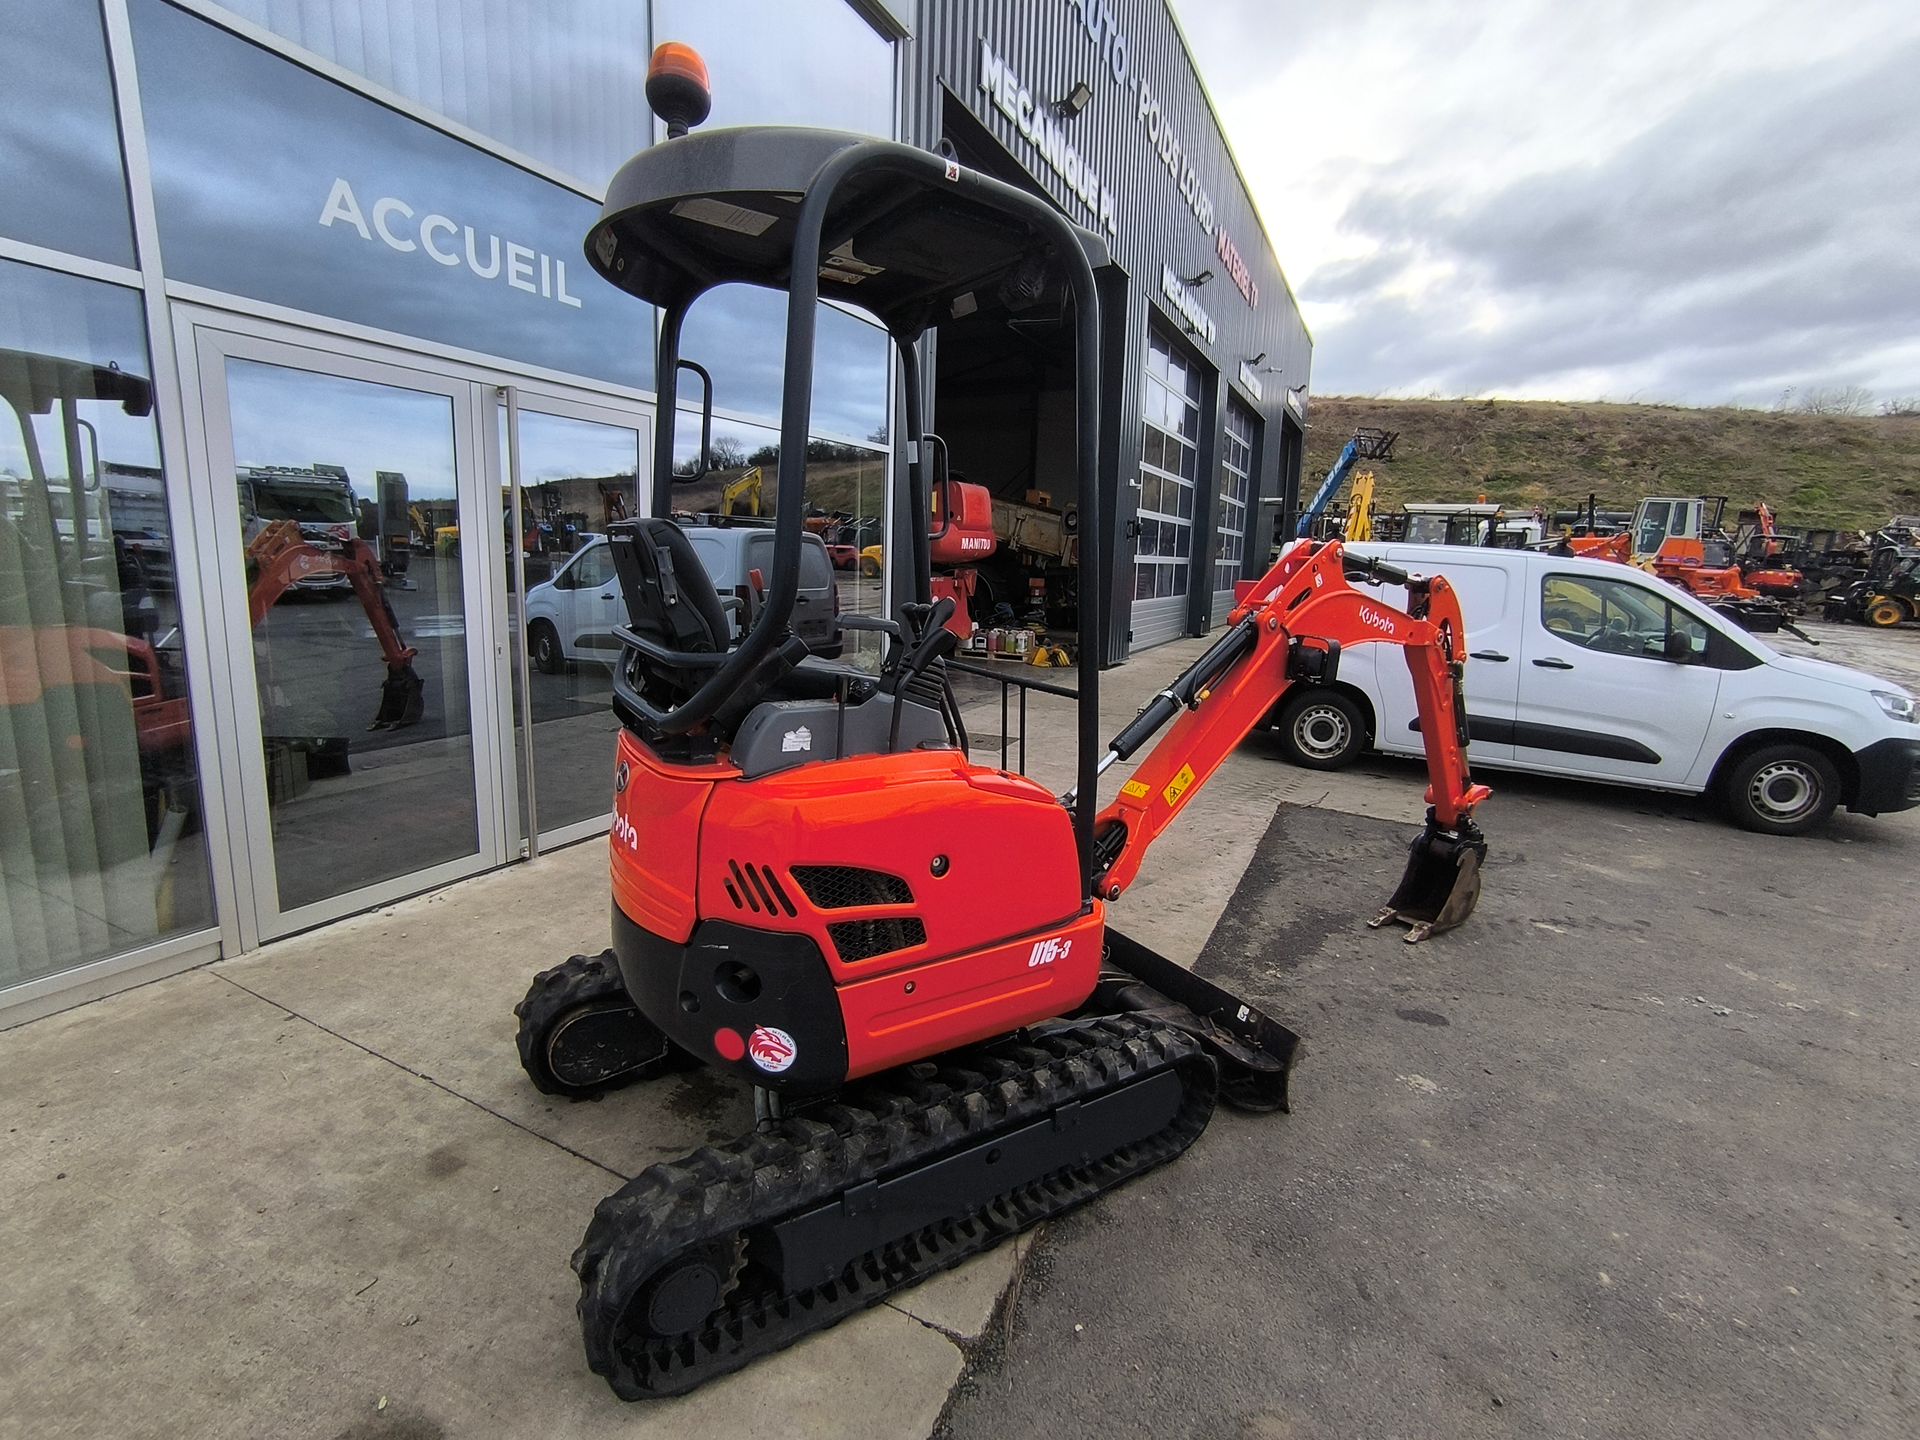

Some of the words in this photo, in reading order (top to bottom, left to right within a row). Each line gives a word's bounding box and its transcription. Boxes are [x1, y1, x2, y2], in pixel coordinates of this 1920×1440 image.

[979, 36, 1099, 215] MECANIQUE
[1101, 186, 1116, 237] PL
[1070, 0, 1127, 85] UTO
[1138, 78, 1180, 178] POIDS
[1180, 154, 1214, 235] LOURD
[318, 177, 582, 308] ACCUEIL
[1359, 604, 1395, 635] Kubota
[612, 800, 638, 850] bota
[1028, 937, 1072, 967] U15-3
